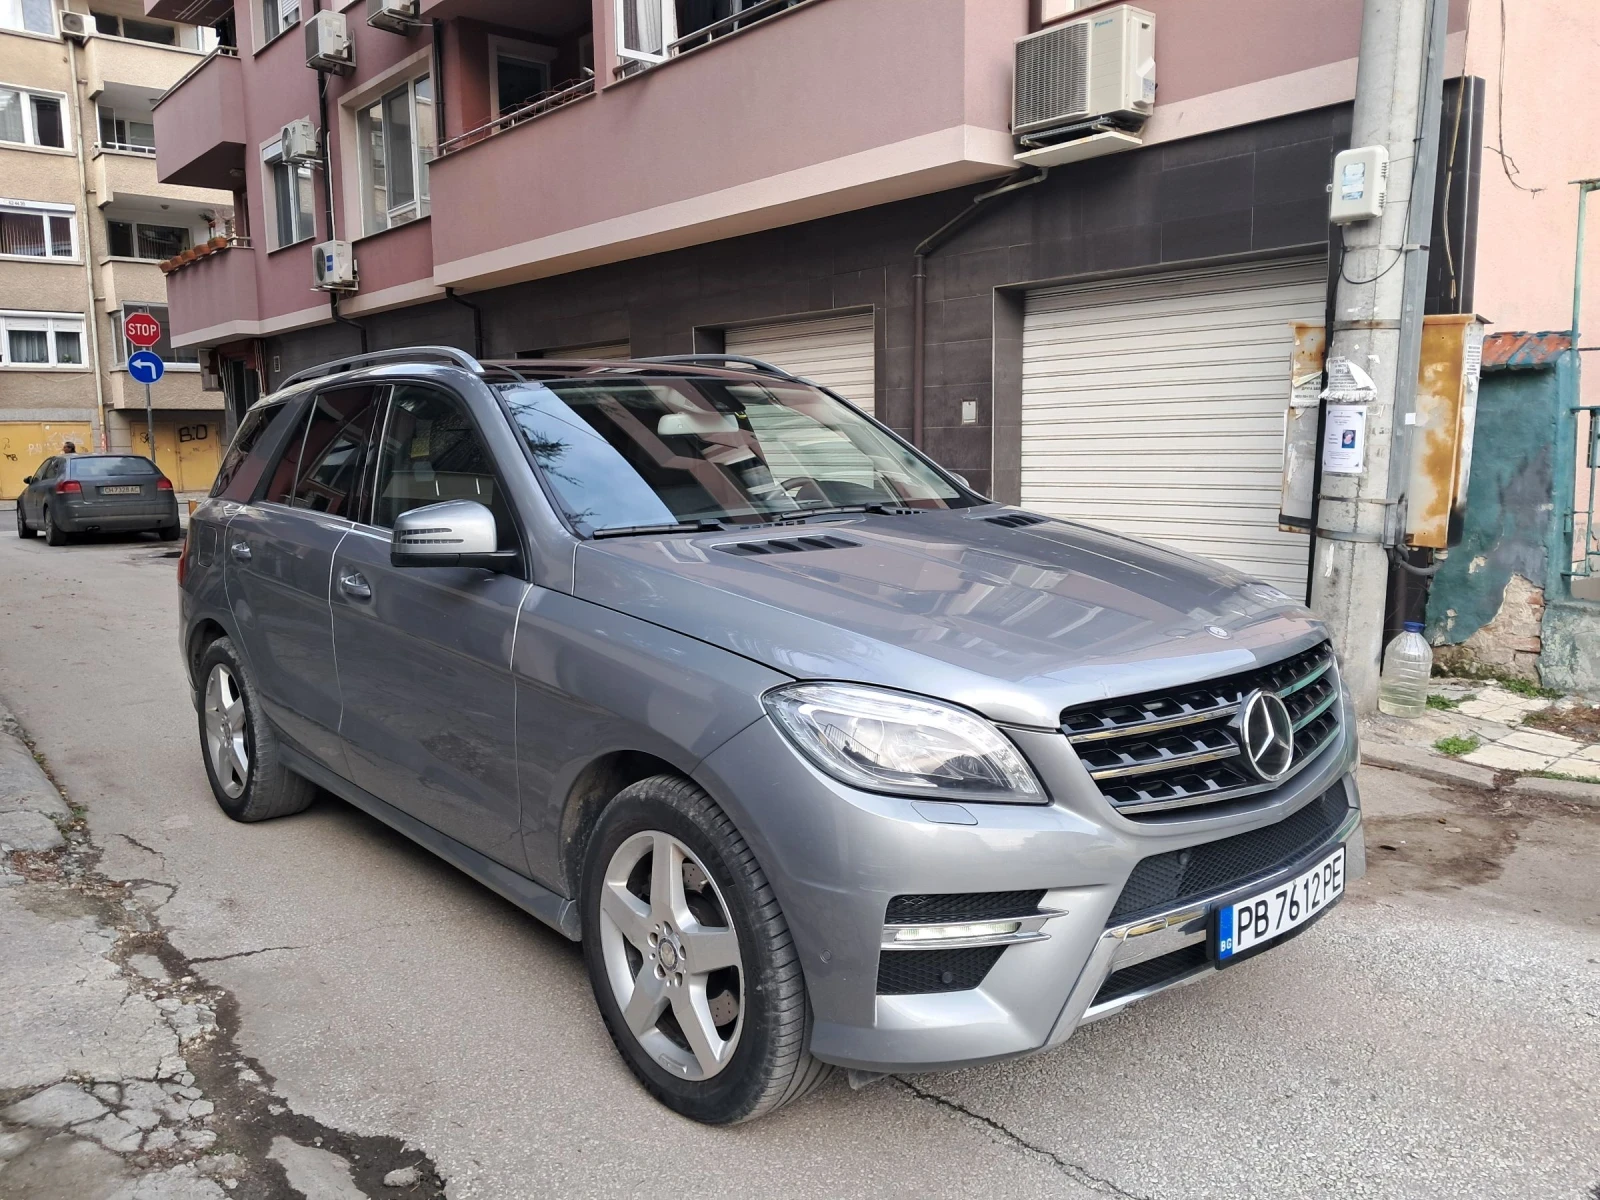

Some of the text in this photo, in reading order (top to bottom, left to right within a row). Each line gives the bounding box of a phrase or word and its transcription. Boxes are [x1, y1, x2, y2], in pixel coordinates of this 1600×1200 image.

[128, 323, 157, 336] STOP
[1237, 855, 1342, 946] PB 7612 PE
[1220, 938, 1232, 952] BG
